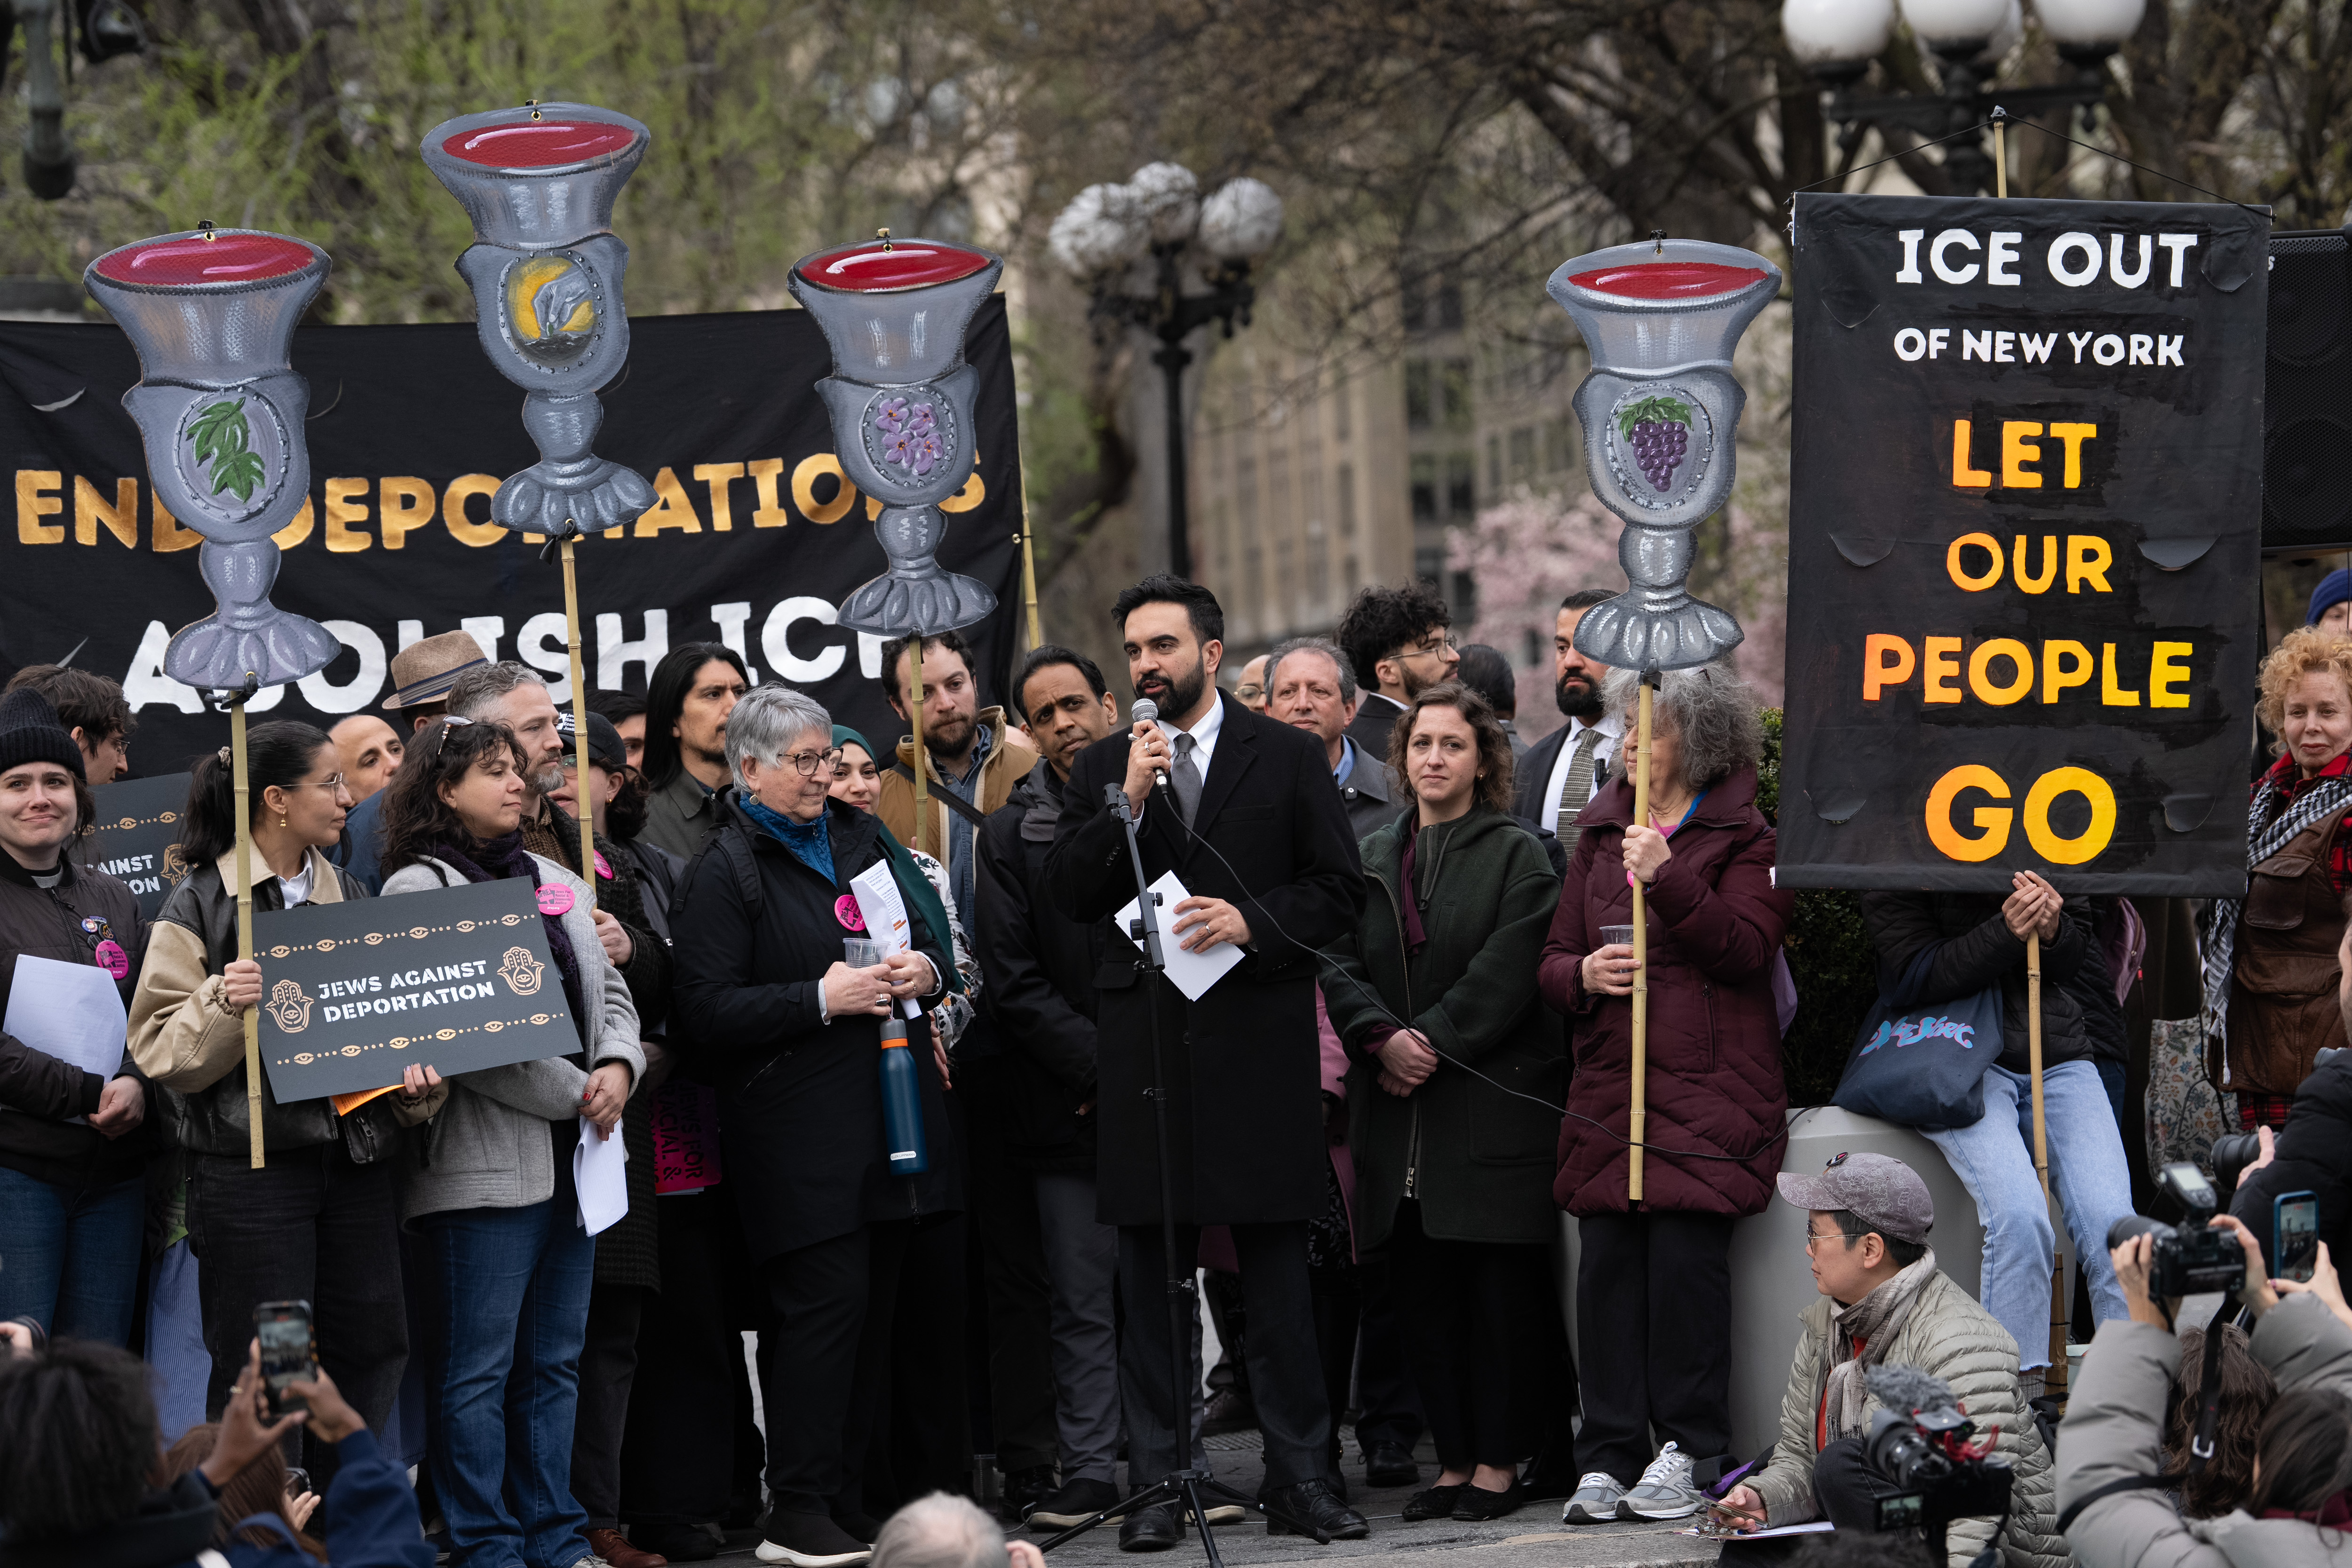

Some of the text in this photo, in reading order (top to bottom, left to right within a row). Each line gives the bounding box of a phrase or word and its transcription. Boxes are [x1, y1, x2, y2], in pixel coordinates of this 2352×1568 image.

[1896, 228, 2198, 288] ICE OUT
[1894, 328, 2185, 366] OF NEW YORK
[1953, 419, 2097, 488] LET
[1947, 532, 2113, 594] OUR
[1863, 633, 2193, 708] PEOPLE
[1925, 764, 2117, 865] GO
[86, 854, 153, 876] AINST
[318, 960, 486, 999] JEWS AGAINST
[323, 981, 495, 1023] DEPORTATION
[657, 1083, 682, 1182] RACIAL &
[683, 1139, 704, 1179] FOR
